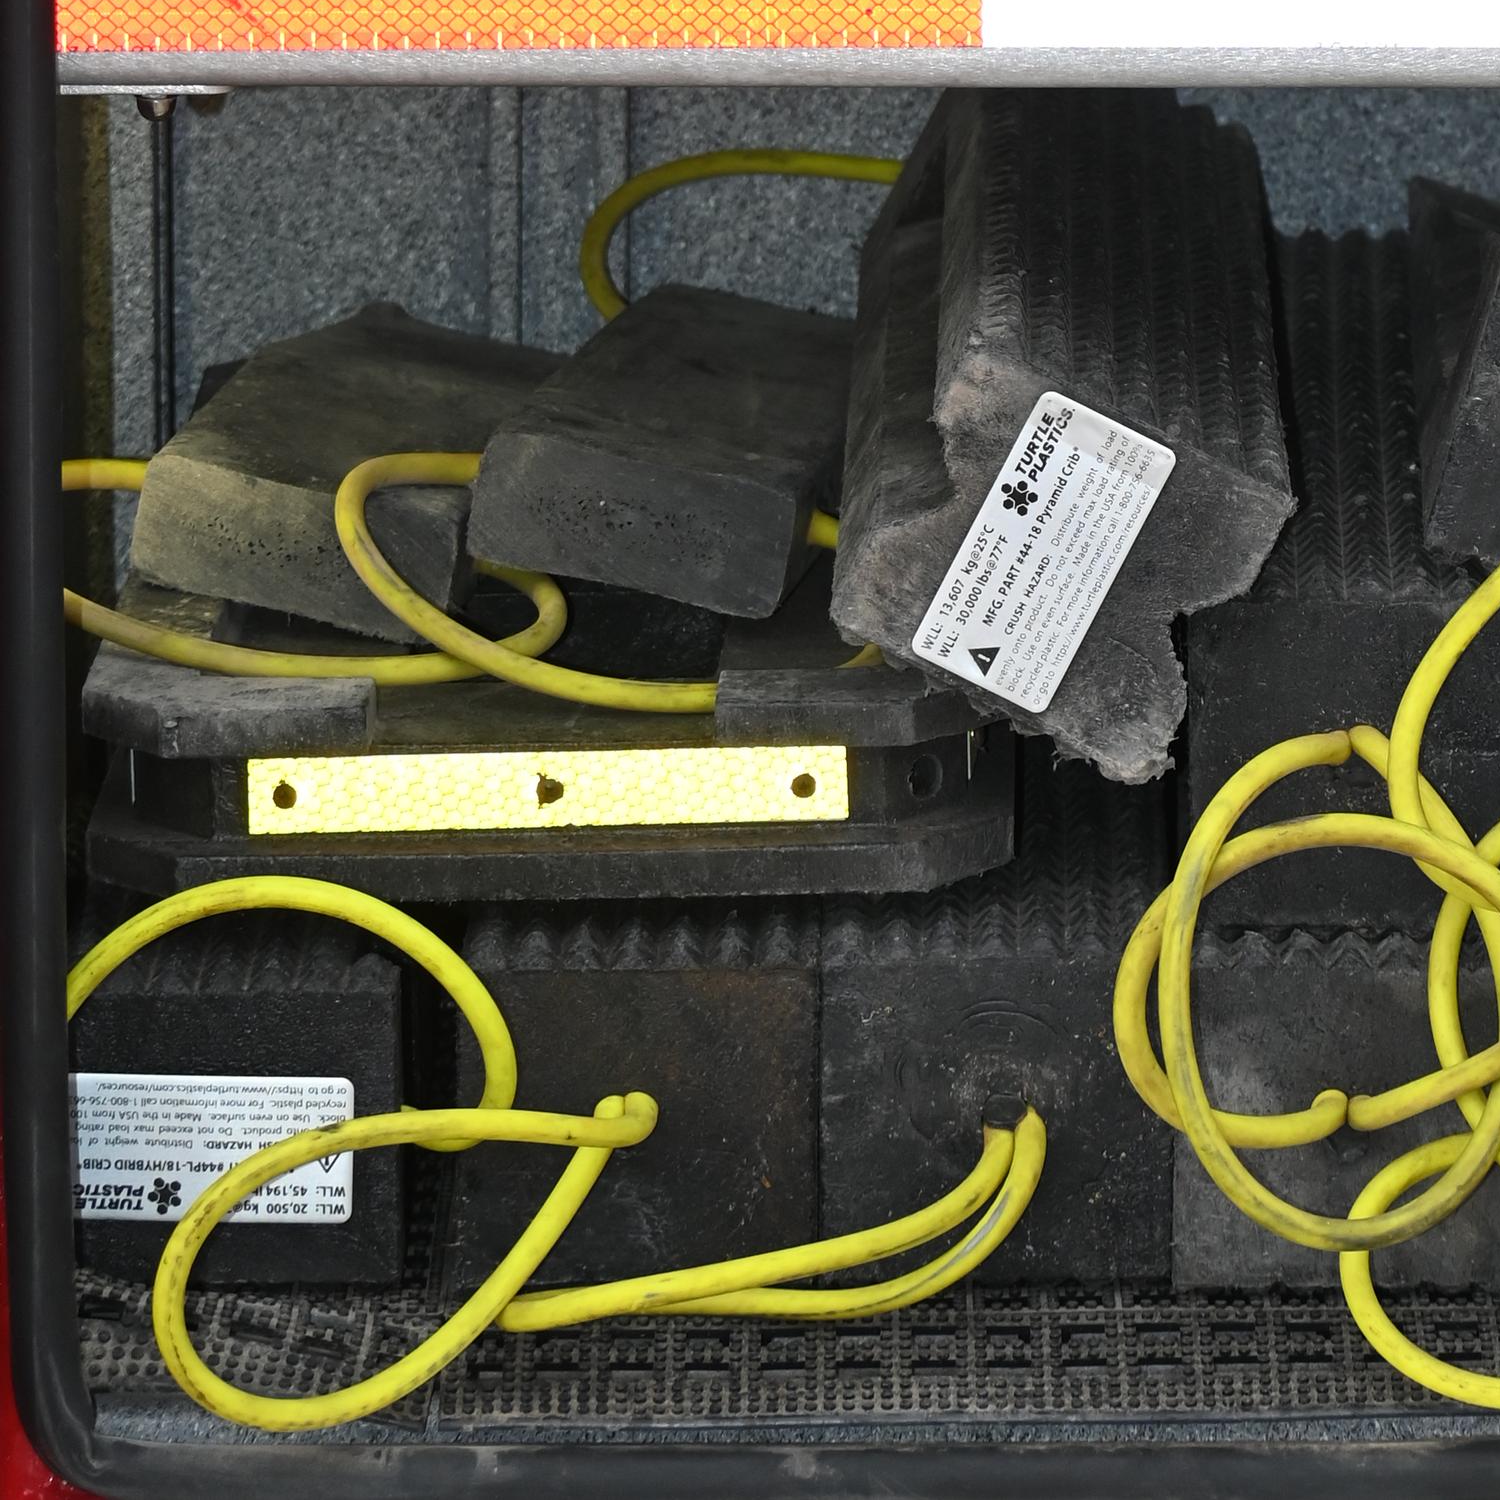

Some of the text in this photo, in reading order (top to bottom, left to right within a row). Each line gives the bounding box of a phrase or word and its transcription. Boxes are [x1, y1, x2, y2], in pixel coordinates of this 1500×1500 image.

[1015, 412, 1055, 475] TURTLE
[1028, 407, 1075, 483] PLASTICS.
[982, 598, 1006, 627] MFG.
[999, 565, 1021, 597] PART
[1016, 526, 1042, 566] #44-18
[1036, 476, 1068, 525] Pyramid
[1004, 430, 1118, 636] CRUSH HAZARD: Distribute weight of load
[921, 524, 995, 650] WLL: 13,607 kg@25°C
[937, 534, 1008, 658] WLL: 30,000 lbs@77°F
[88, 1138, 252, 1150] HAZARD: Distribute weight of
[115, 1160, 224, 1172] #44PL-18/HYBRID
[72, 1184, 145, 1196] PLASTIC
[75, 1197, 144, 1210] TURTLE
[266, 1185, 346, 1197] WLL: 45,194
[267, 1203, 346, 1215] WLL: 20,500
